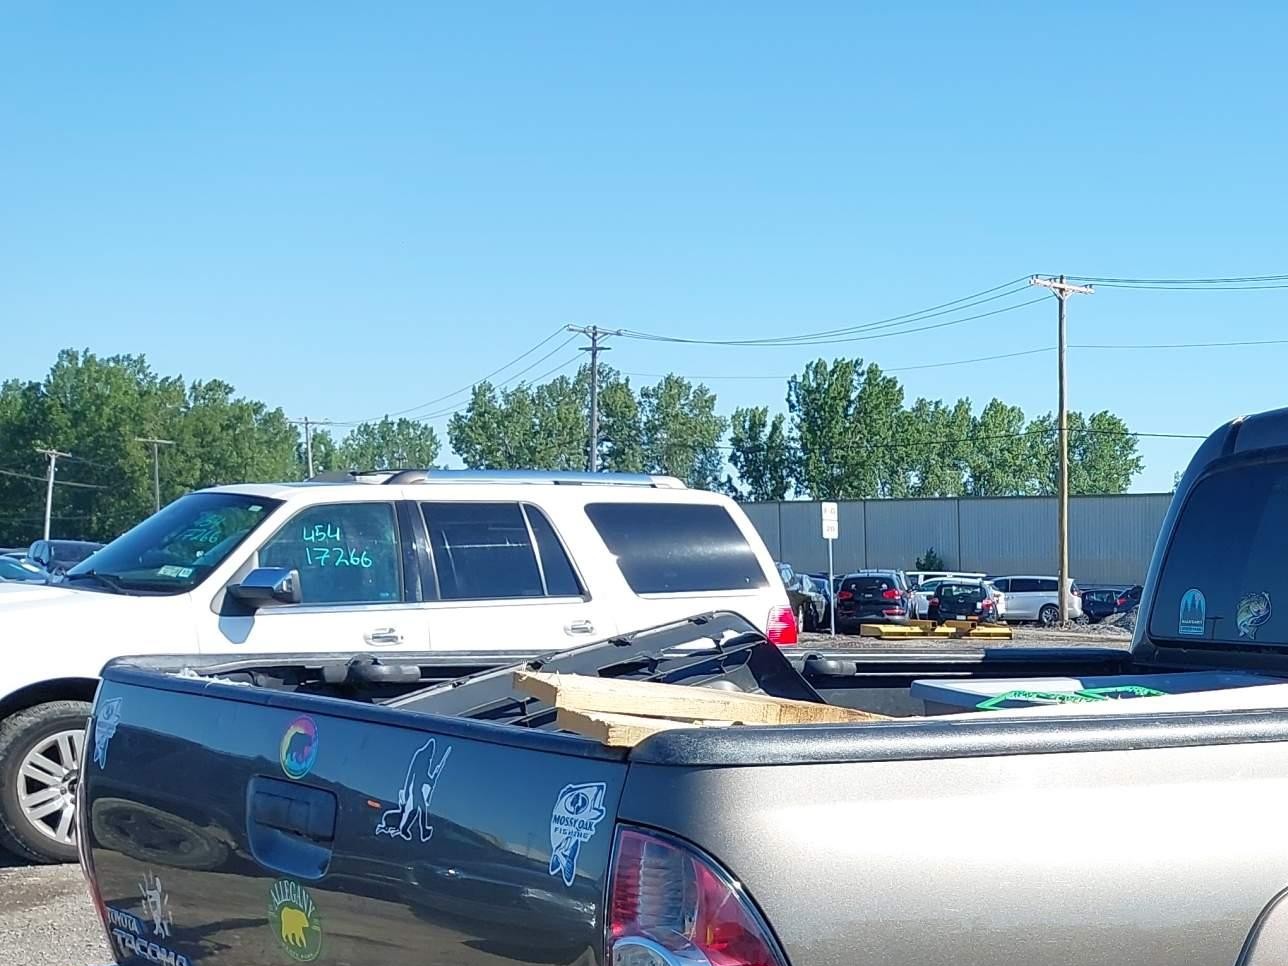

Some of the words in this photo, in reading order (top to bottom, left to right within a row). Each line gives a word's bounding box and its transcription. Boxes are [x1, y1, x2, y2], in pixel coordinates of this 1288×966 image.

[303, 523, 341, 543] 454
[305, 547, 373, 568] 17266
[553, 814, 578, 828] MOSSY
[577, 819, 595, 831] OAK
[554, 827, 589, 839] FISHING
[270, 879, 316, 919] ALLEGANY
[107, 908, 140, 935] TOYOTA
